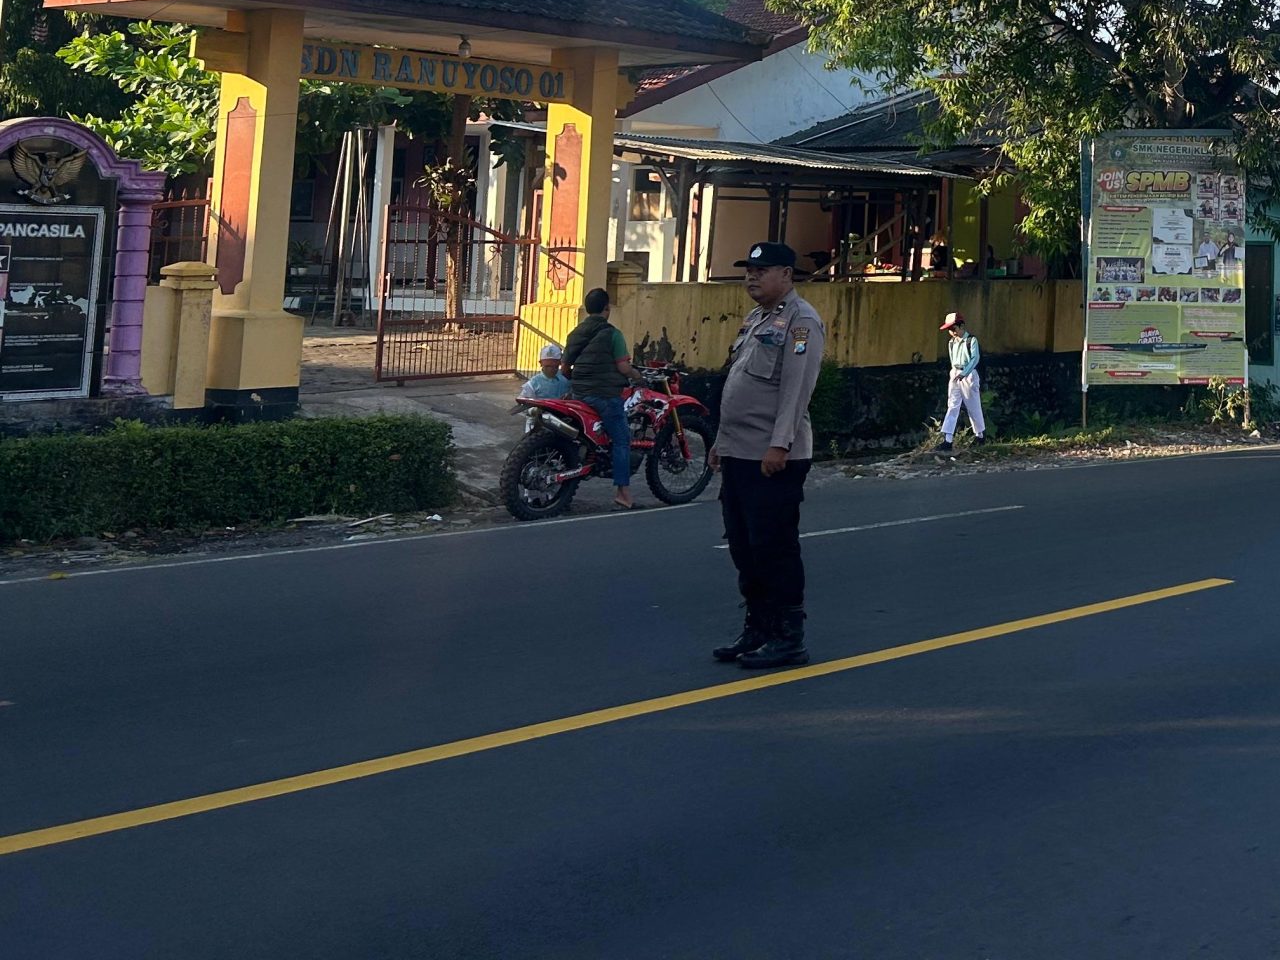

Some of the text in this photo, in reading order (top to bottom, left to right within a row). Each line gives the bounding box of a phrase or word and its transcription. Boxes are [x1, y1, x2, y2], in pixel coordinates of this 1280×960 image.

[373, 52, 533, 95] RANUYOSO
[539, 71, 566, 98] 01
[1132, 144, 1153, 153] SMK
[1156, 145, 1192, 154] NEGERI
[1097, 171, 1124, 182] JOIN
[1126, 170, 1191, 192] SPMB
[1106, 179, 1125, 190] US!
